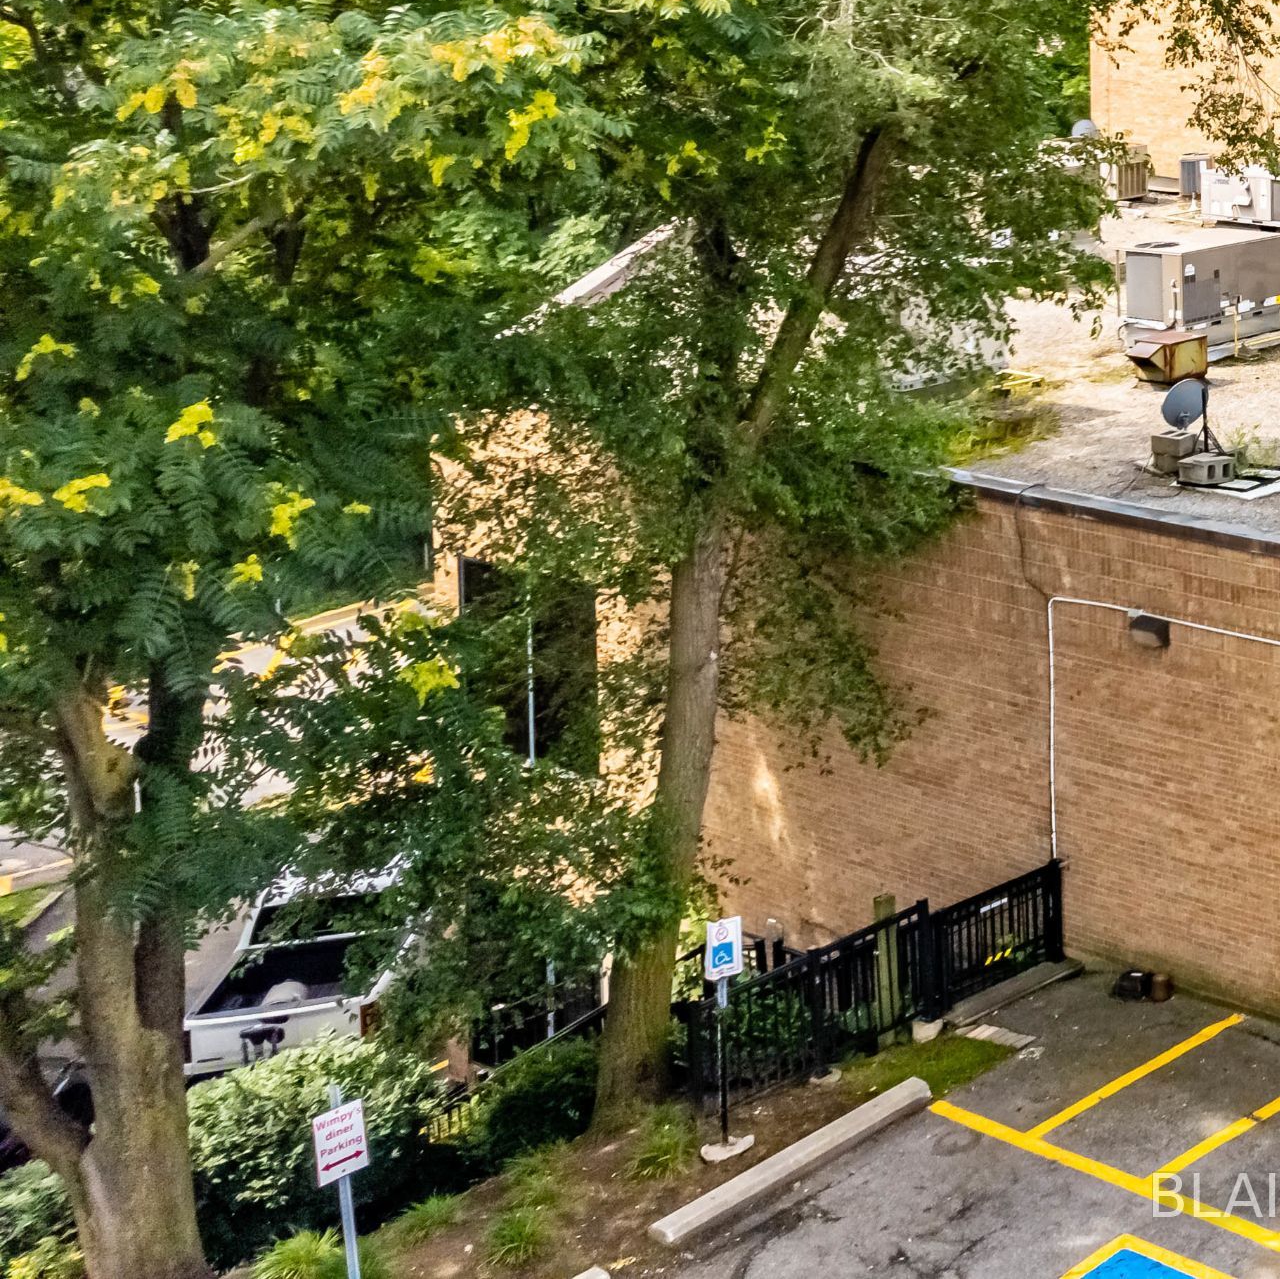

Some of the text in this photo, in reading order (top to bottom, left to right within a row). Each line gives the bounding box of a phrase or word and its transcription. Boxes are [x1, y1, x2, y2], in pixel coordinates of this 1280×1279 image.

[315, 1106, 362, 1132] Wimpy's
[325, 1123, 354, 1141] diner
[320, 1134, 363, 1158] Parking
